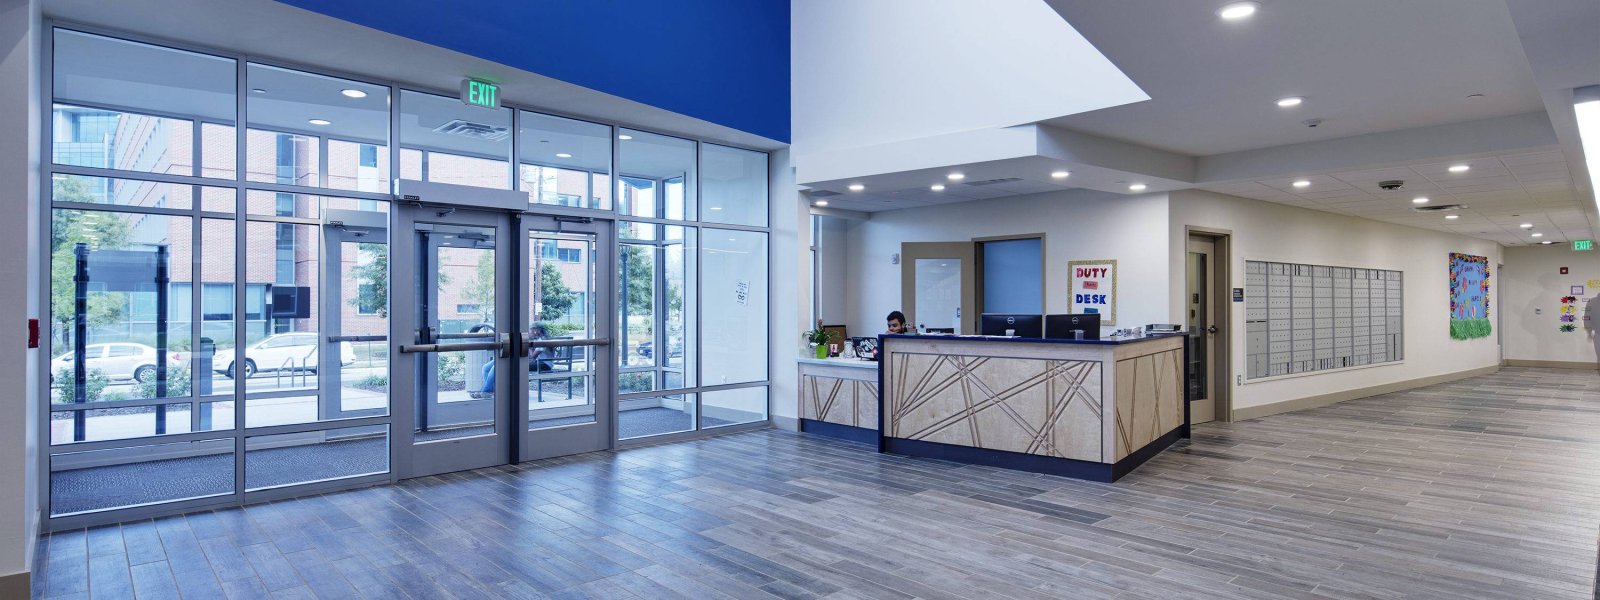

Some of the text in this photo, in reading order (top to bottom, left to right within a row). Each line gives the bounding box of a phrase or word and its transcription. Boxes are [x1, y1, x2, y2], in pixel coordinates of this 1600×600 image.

[469, 80, 497, 108] EXIT
[1574, 240, 1591, 251] EXIT
[1076, 267, 1107, 278] DUTY
[1075, 293, 1107, 305] DESK
